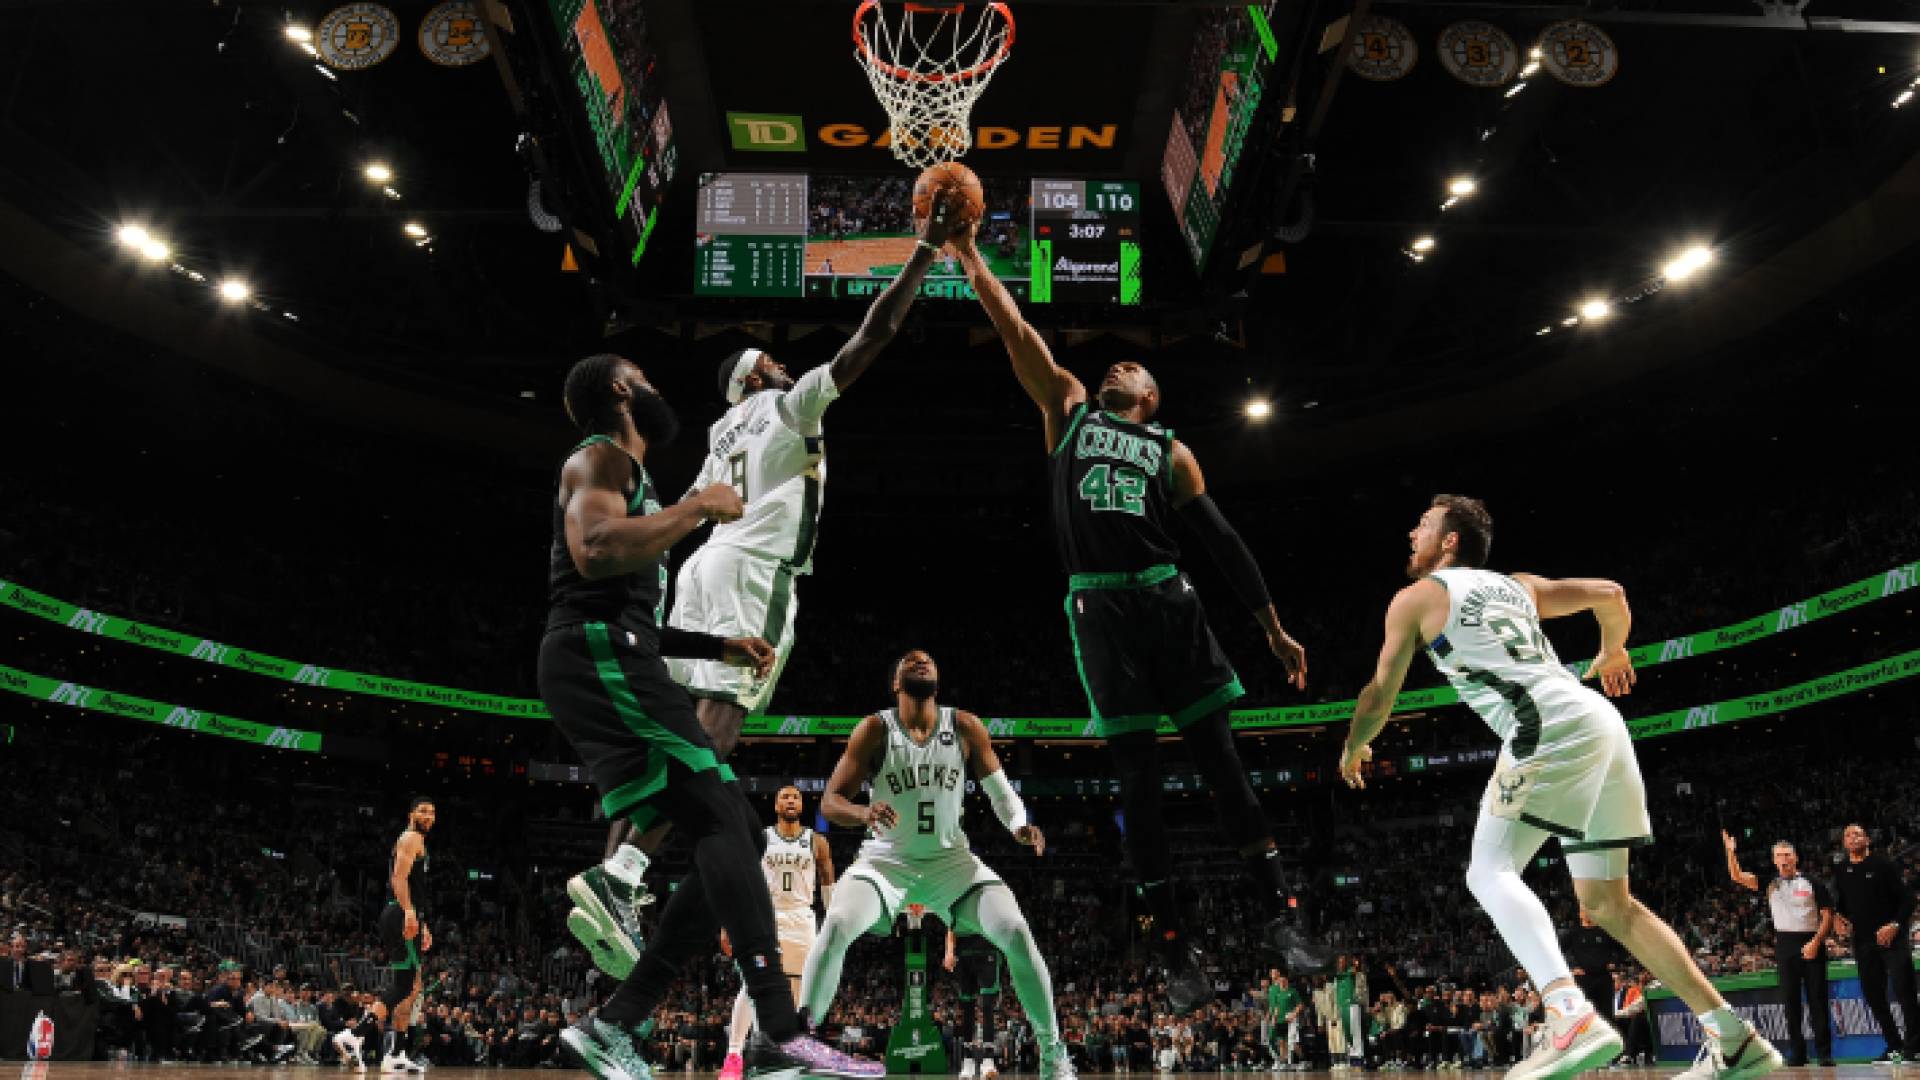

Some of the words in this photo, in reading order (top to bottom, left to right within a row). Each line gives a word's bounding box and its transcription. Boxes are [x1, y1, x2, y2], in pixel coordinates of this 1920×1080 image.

[734, 118, 798, 144] TD
[1042, 192, 1079, 209] 104
[1096, 194, 1133, 211] 110
[1069, 224, 1106, 239] 3:07
[1076, 424, 1163, 476] CELTICS
[1079, 463, 1147, 517] 42
[886, 763, 960, 795] BUCKS
[917, 801, 935, 834] 5
[783, 871, 792, 892] 0
